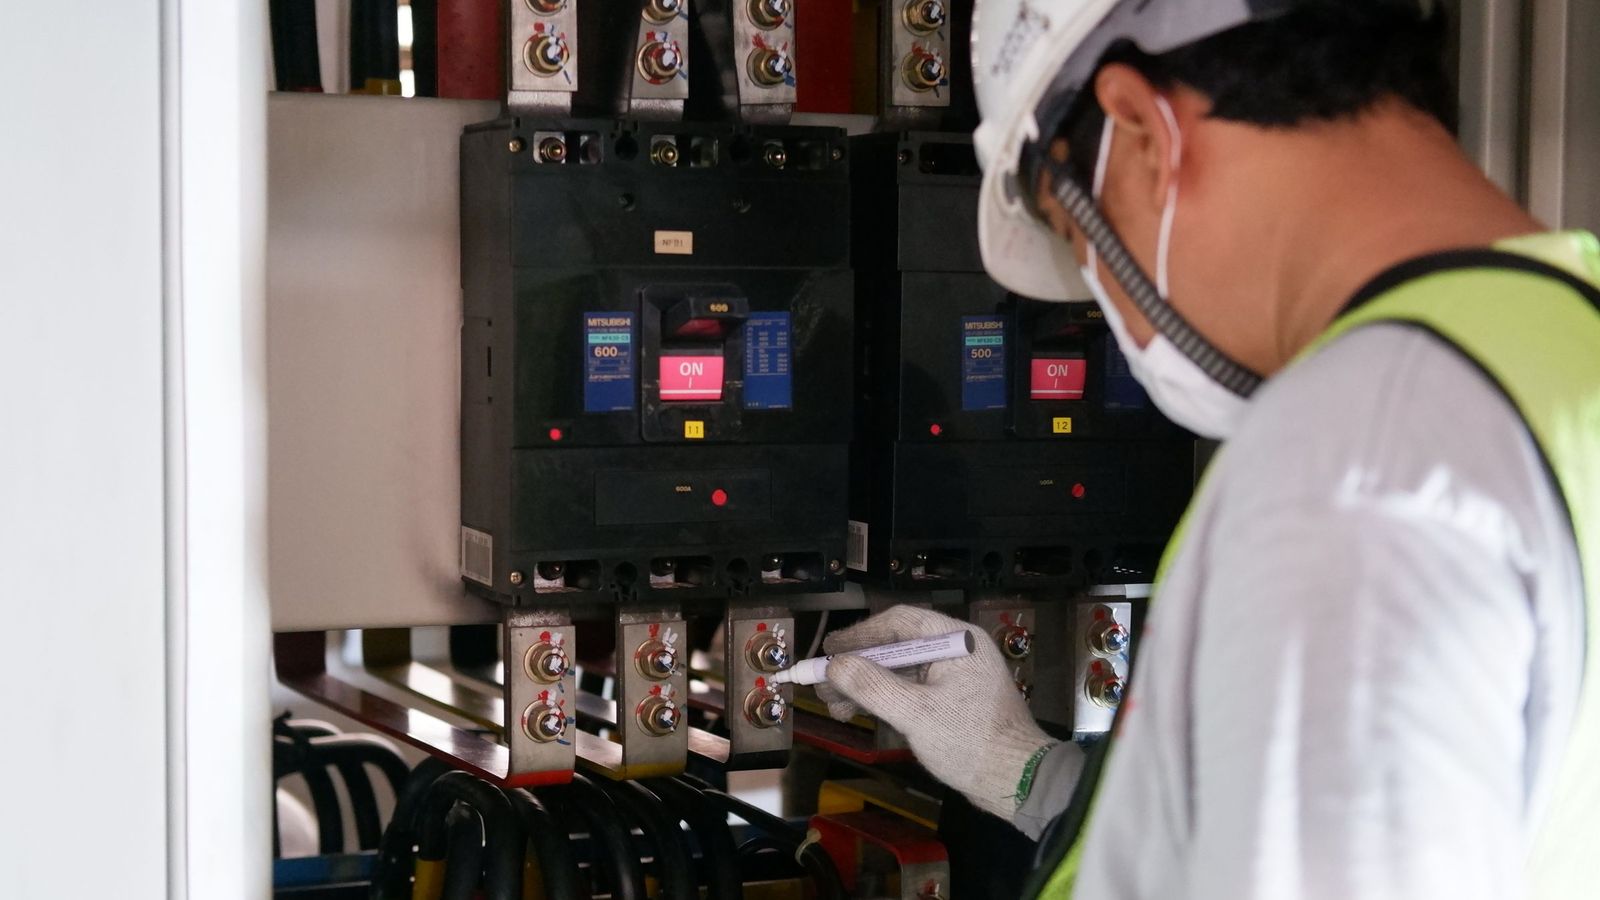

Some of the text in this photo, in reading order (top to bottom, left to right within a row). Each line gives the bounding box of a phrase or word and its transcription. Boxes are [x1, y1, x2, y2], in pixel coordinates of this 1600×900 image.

[709, 303, 729, 313] 600
[587, 317, 631, 328] MITSUBISHI
[964, 321, 1003, 330] MITSUBISHI
[594, 346, 618, 358] 600
[971, 348, 992, 359] 500
[679, 362, 704, 377] ON
[1047, 364, 1069, 377] ON
[687, 424, 700, 435] 11
[1056, 421, 1069, 430] 12
